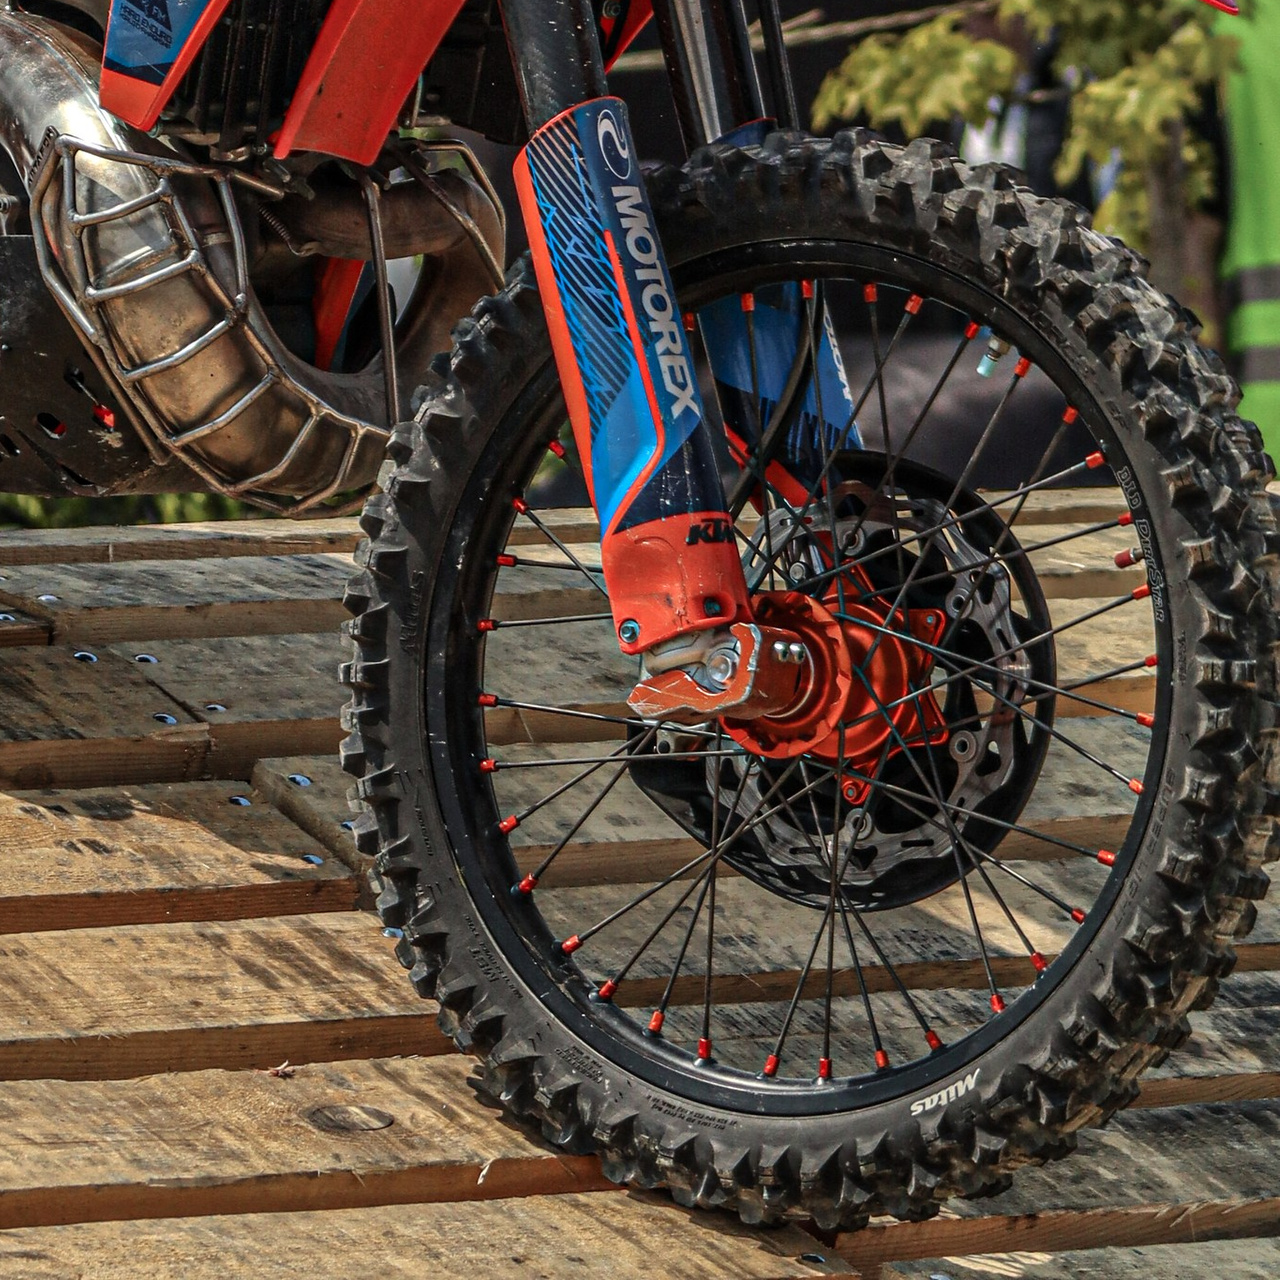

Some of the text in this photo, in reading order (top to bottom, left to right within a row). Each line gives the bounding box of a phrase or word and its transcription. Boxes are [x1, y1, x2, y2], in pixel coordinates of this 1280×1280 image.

[611, 184, 700, 421] MOTOREX
[686, 517, 733, 546] KTM
[909, 1068, 980, 1116] Mitas
